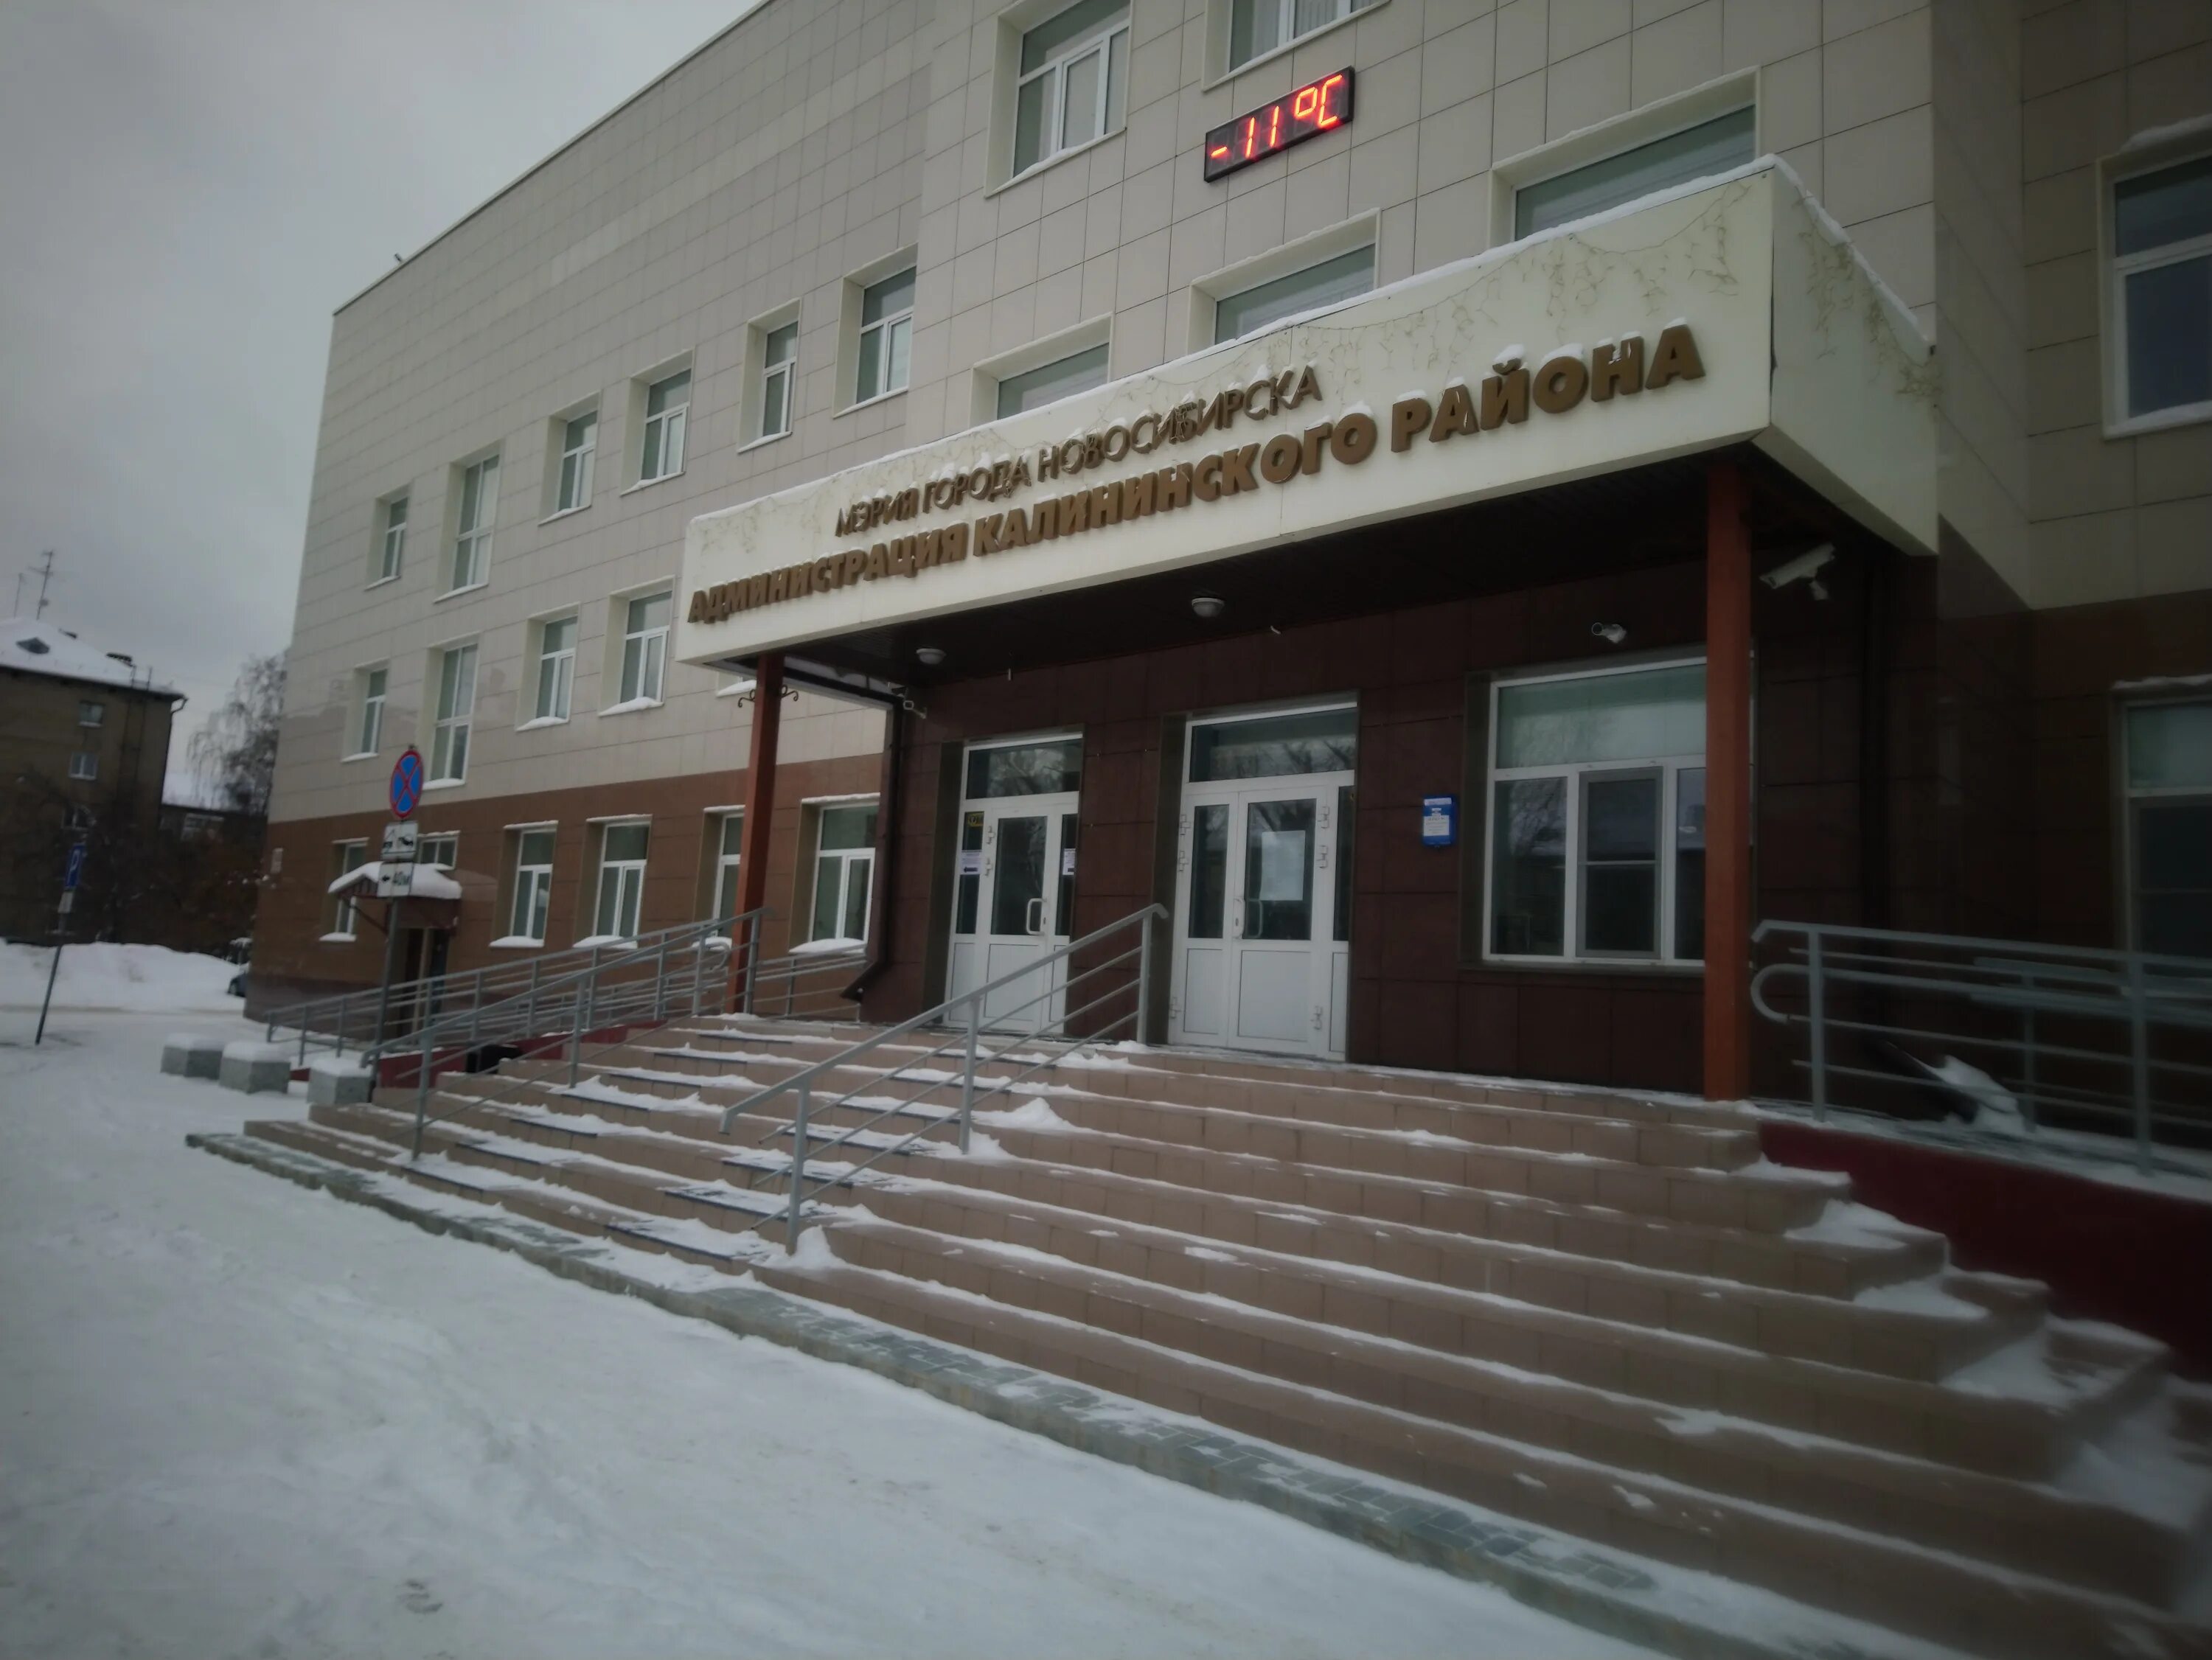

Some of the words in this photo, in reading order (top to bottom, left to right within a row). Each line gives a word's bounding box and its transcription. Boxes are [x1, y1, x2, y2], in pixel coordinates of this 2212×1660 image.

[687, 522, 969, 624] АДМИНИСТРАЦИЯ
[973, 413, 1377, 557] КАЛИНИНСКОГО
[1391, 324, 1705, 453] РАЙОНА
[835, 487, 919, 537] МЭРИЯ
[922, 454, 1032, 514] ГОРОДА
[1039, 365, 1323, 483] НОВОСИБИРСКА
